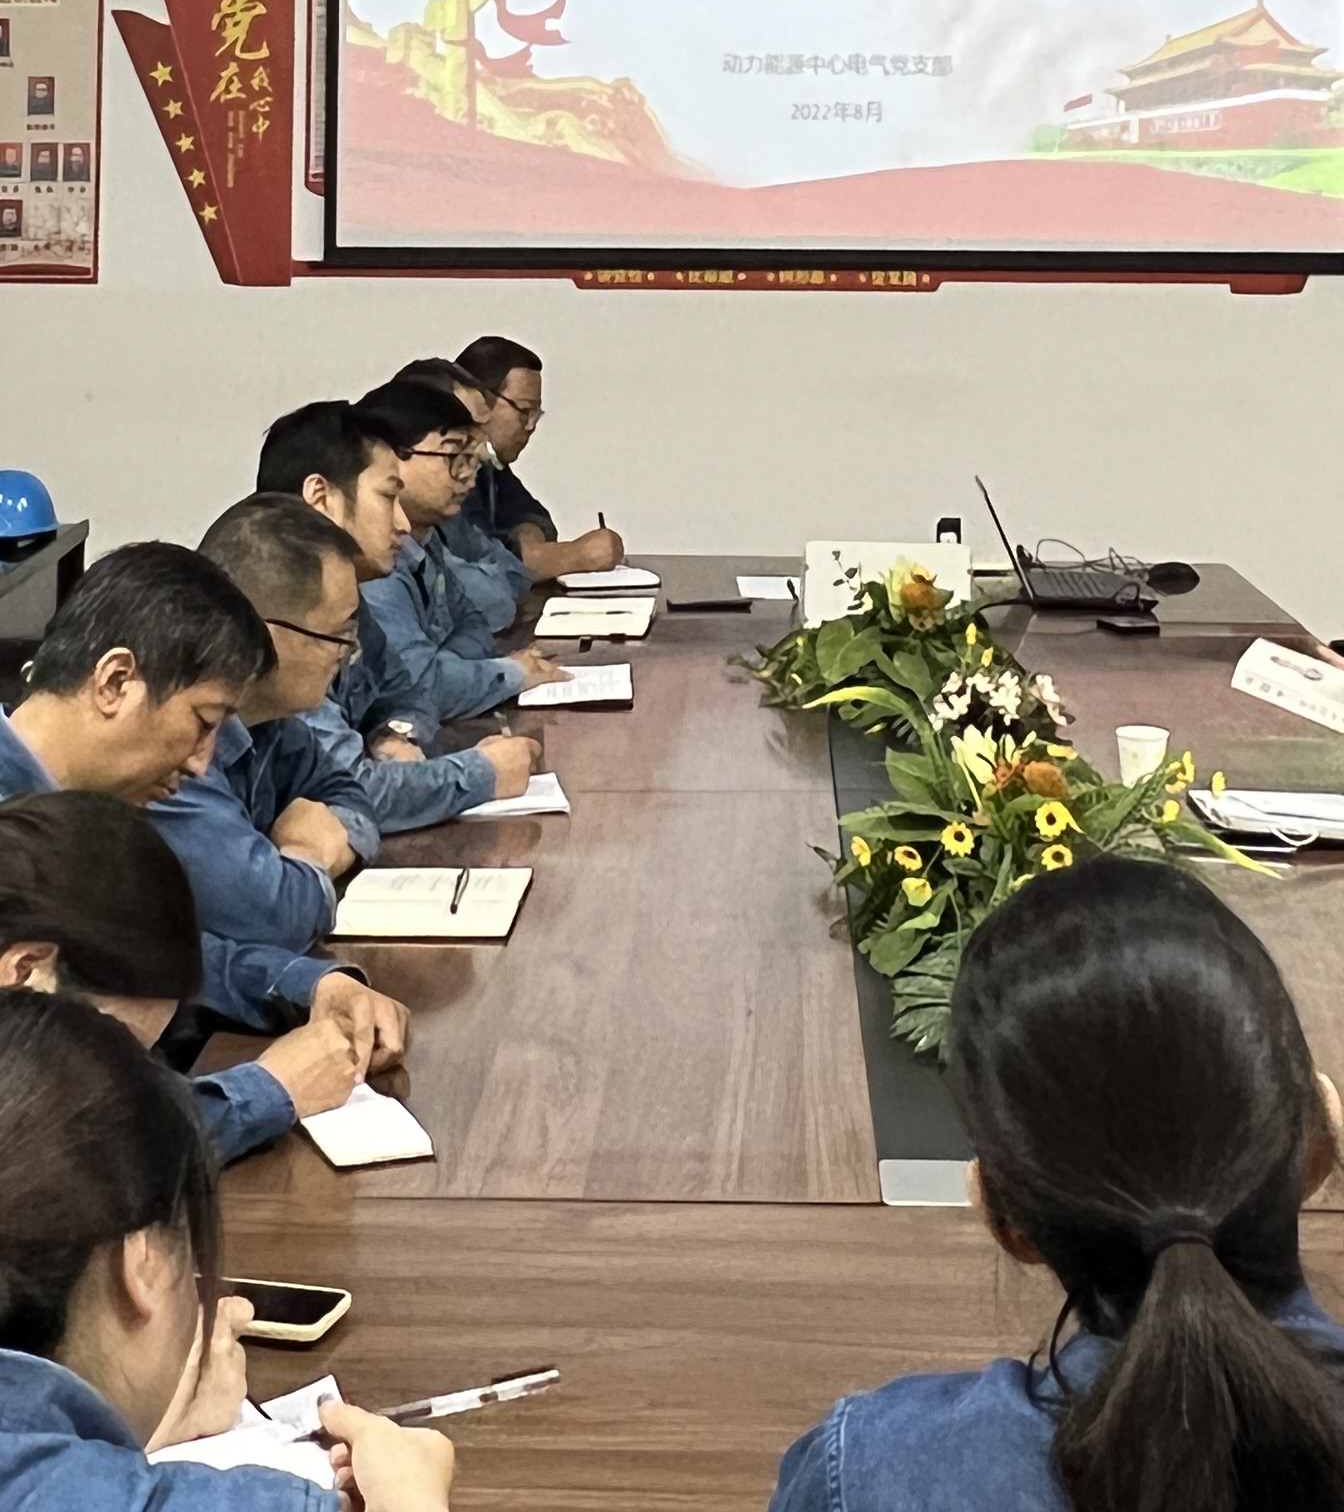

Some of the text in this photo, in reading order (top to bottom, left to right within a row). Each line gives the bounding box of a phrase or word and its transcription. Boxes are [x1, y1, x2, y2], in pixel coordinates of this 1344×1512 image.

[722, 53, 953, 76] 动力能源中心电气党支部
[790, 101, 883, 124] 2022年8月
